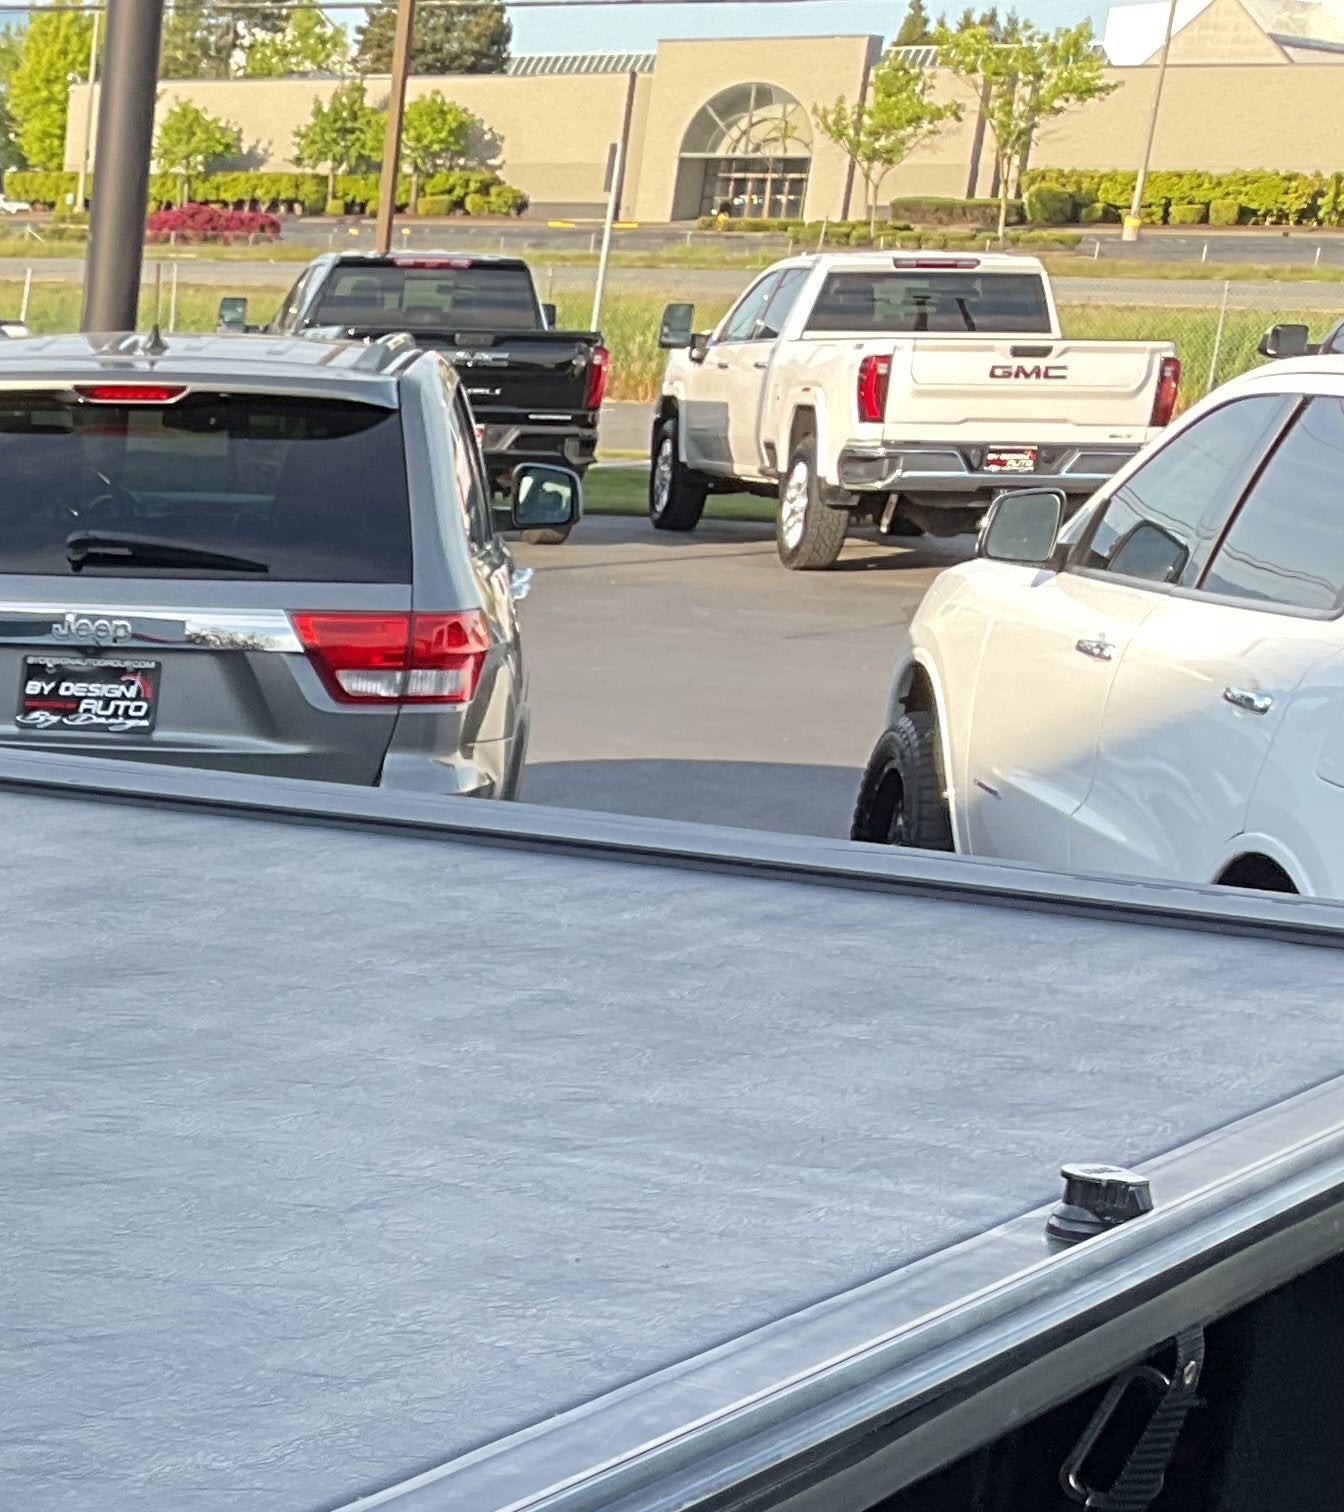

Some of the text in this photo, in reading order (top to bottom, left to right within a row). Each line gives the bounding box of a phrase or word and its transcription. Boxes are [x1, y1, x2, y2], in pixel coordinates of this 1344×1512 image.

[989, 365, 1069, 379] GMC
[52, 613, 132, 644] Jeep
[25, 680, 138, 698] BY DESIGN
[78, 699, 148, 717] AUTO
